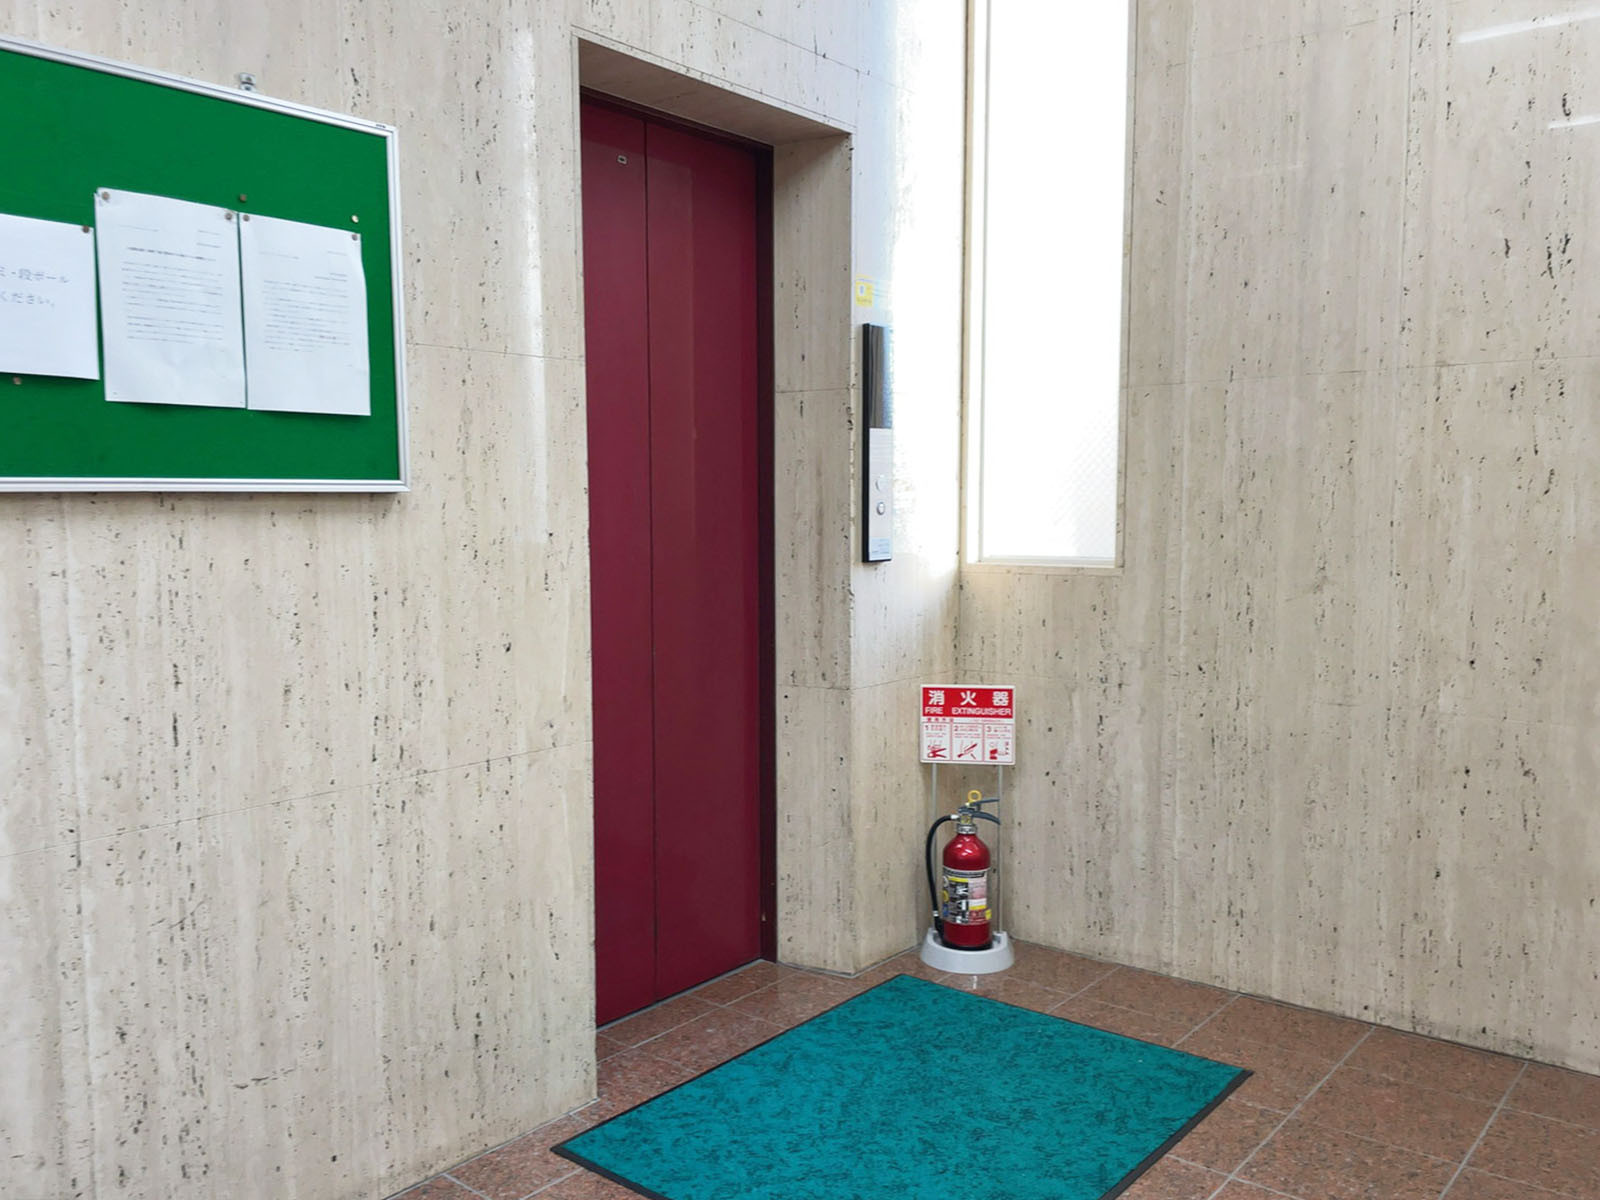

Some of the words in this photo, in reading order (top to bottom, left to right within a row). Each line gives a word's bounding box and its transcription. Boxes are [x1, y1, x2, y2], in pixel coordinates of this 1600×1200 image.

[928, 690, 1009, 706] 消火器
[951, 707, 1012, 715] EXTINGUISHER
